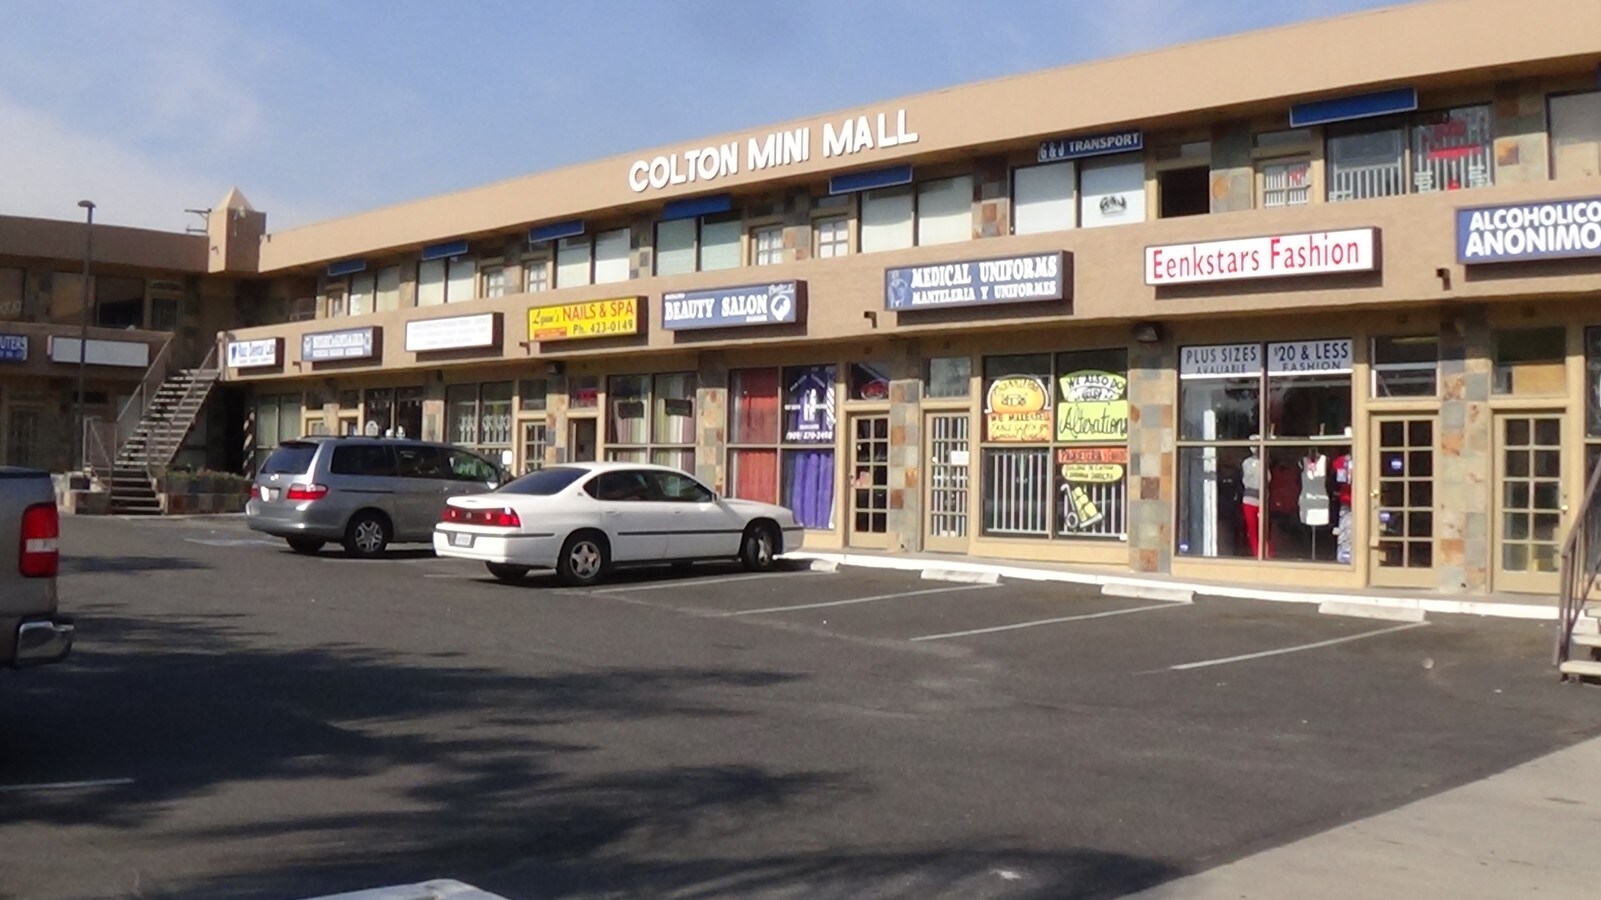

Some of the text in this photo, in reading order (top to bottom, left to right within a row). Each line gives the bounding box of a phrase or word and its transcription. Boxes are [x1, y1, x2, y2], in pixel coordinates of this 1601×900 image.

[629, 109, 919, 193] COLTON MINI MALL
[1069, 132, 1140, 153] TRANSPORT
[1469, 201, 1601, 231] ALCOHOLICO
[1465, 222, 1601, 257] ANONIMO
[1153, 234, 1360, 280] Eenkstars Fashion
[910, 255, 1058, 290] MEDICAL UNIFORMS
[911, 280, 1057, 306] MANTELERIA Y UNIFORMES
[562, 302, 597, 322] NAILS
[598, 303, 607, 319] &
[610, 299, 634, 318] SPA
[664, 293, 768, 321] BEAUTY SALON
[1186, 345, 1257, 365] PLUS SIZES
[1274, 341, 1349, 362] $20 & LESS
[1282, 360, 1342, 372] FASHION
[1084, 373, 1109, 386] ALSO
[1110, 377, 1126, 391] DO
